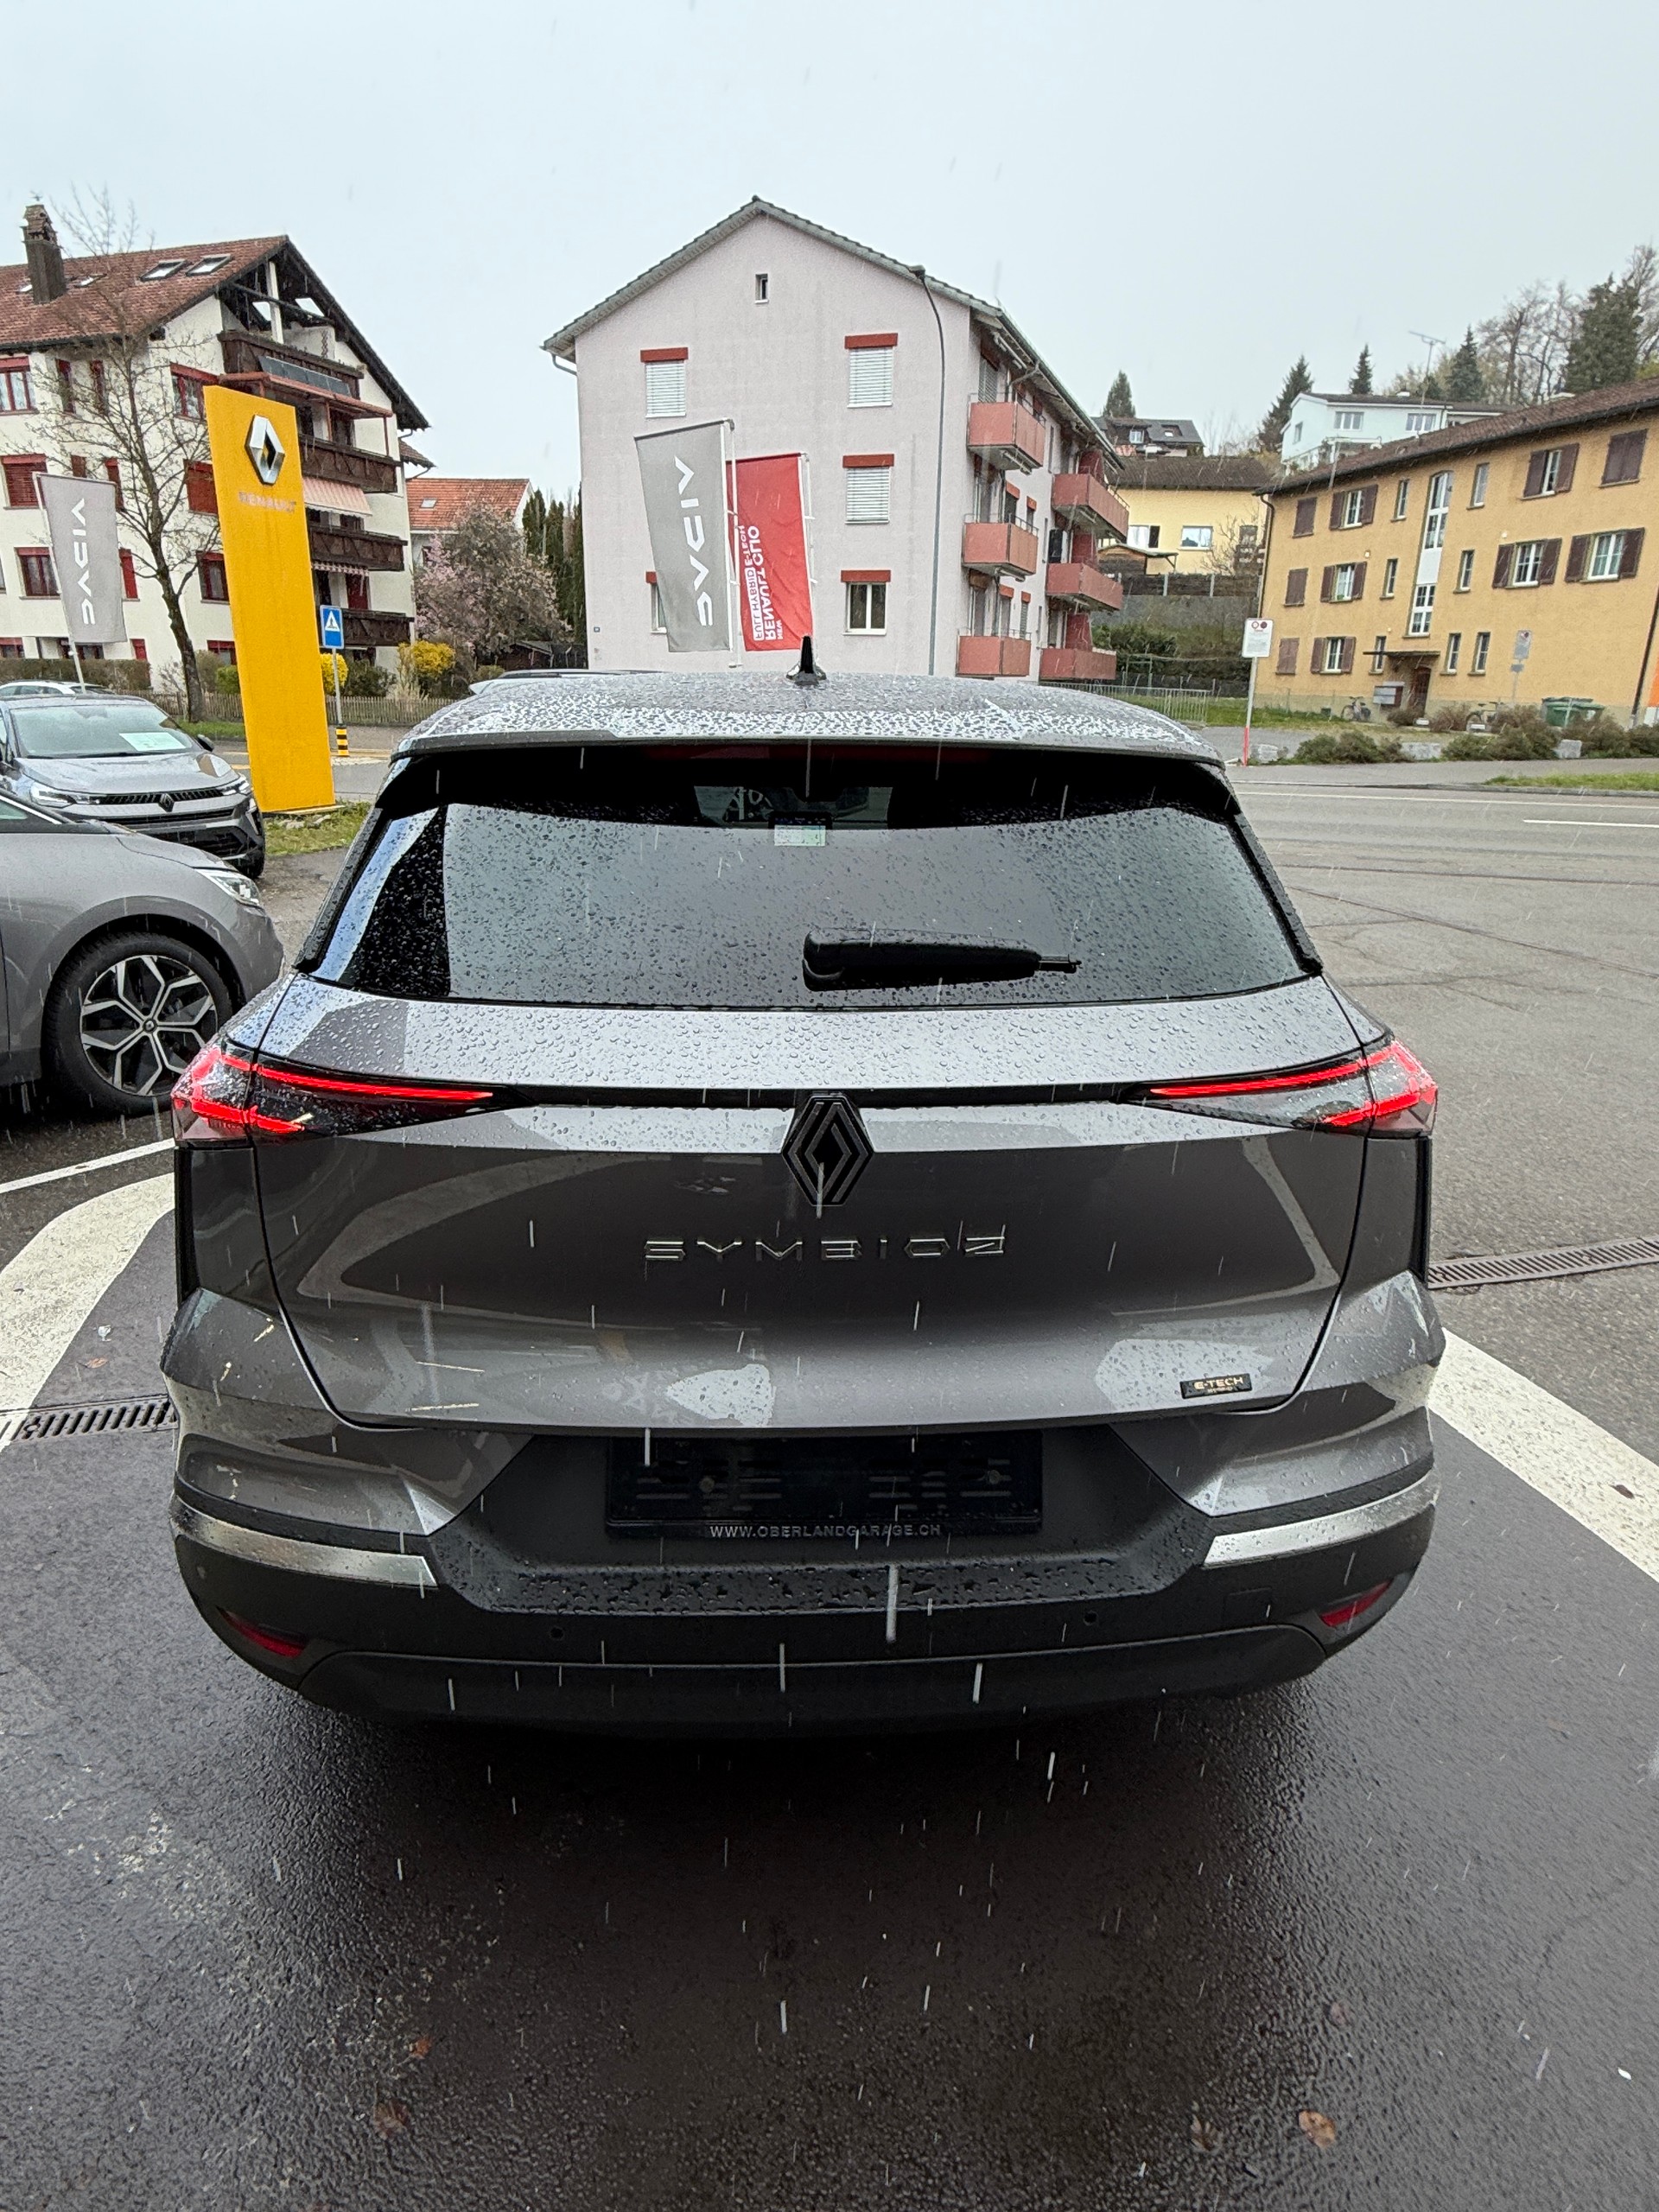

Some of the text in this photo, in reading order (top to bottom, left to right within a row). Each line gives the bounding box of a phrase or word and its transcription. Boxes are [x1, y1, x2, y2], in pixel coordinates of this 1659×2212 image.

[71, 498, 96, 625] DACIA
[645, 1238, 1006, 1261] SYMBIOZ
[1193, 1376, 1244, 1390] E-TECH
[709, 1523, 940, 1539] WWW.OBERLANDGARAGE.CH
